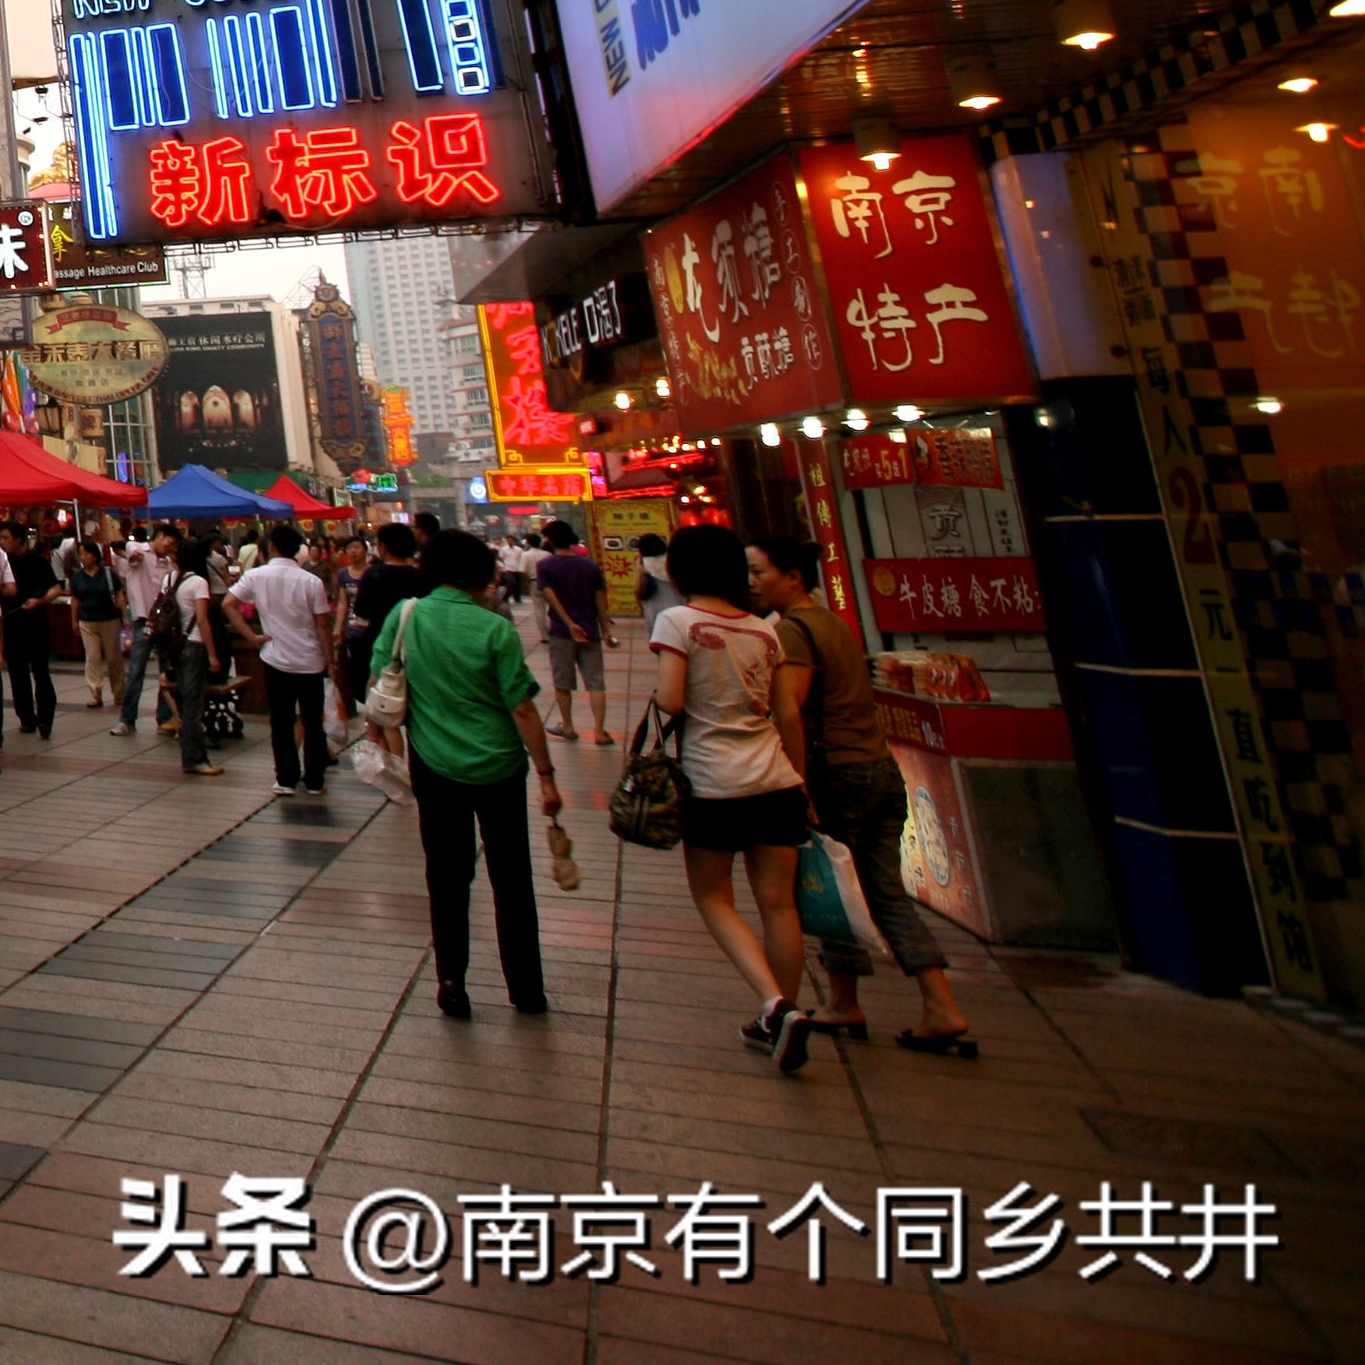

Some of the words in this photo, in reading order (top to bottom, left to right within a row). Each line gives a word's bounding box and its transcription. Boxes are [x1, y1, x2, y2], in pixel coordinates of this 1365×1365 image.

[595, 11, 632, 98] NEW
[150, 112, 500, 226] 新标识
[830, 168, 958, 260] 南京
[54, 267, 85, 281] assage
[87, 263, 136, 278] Healthcare
[137, 260, 158, 274] Club
[845, 282, 989, 374] 特产
[899, 573, 964, 621] 牛皮糖
